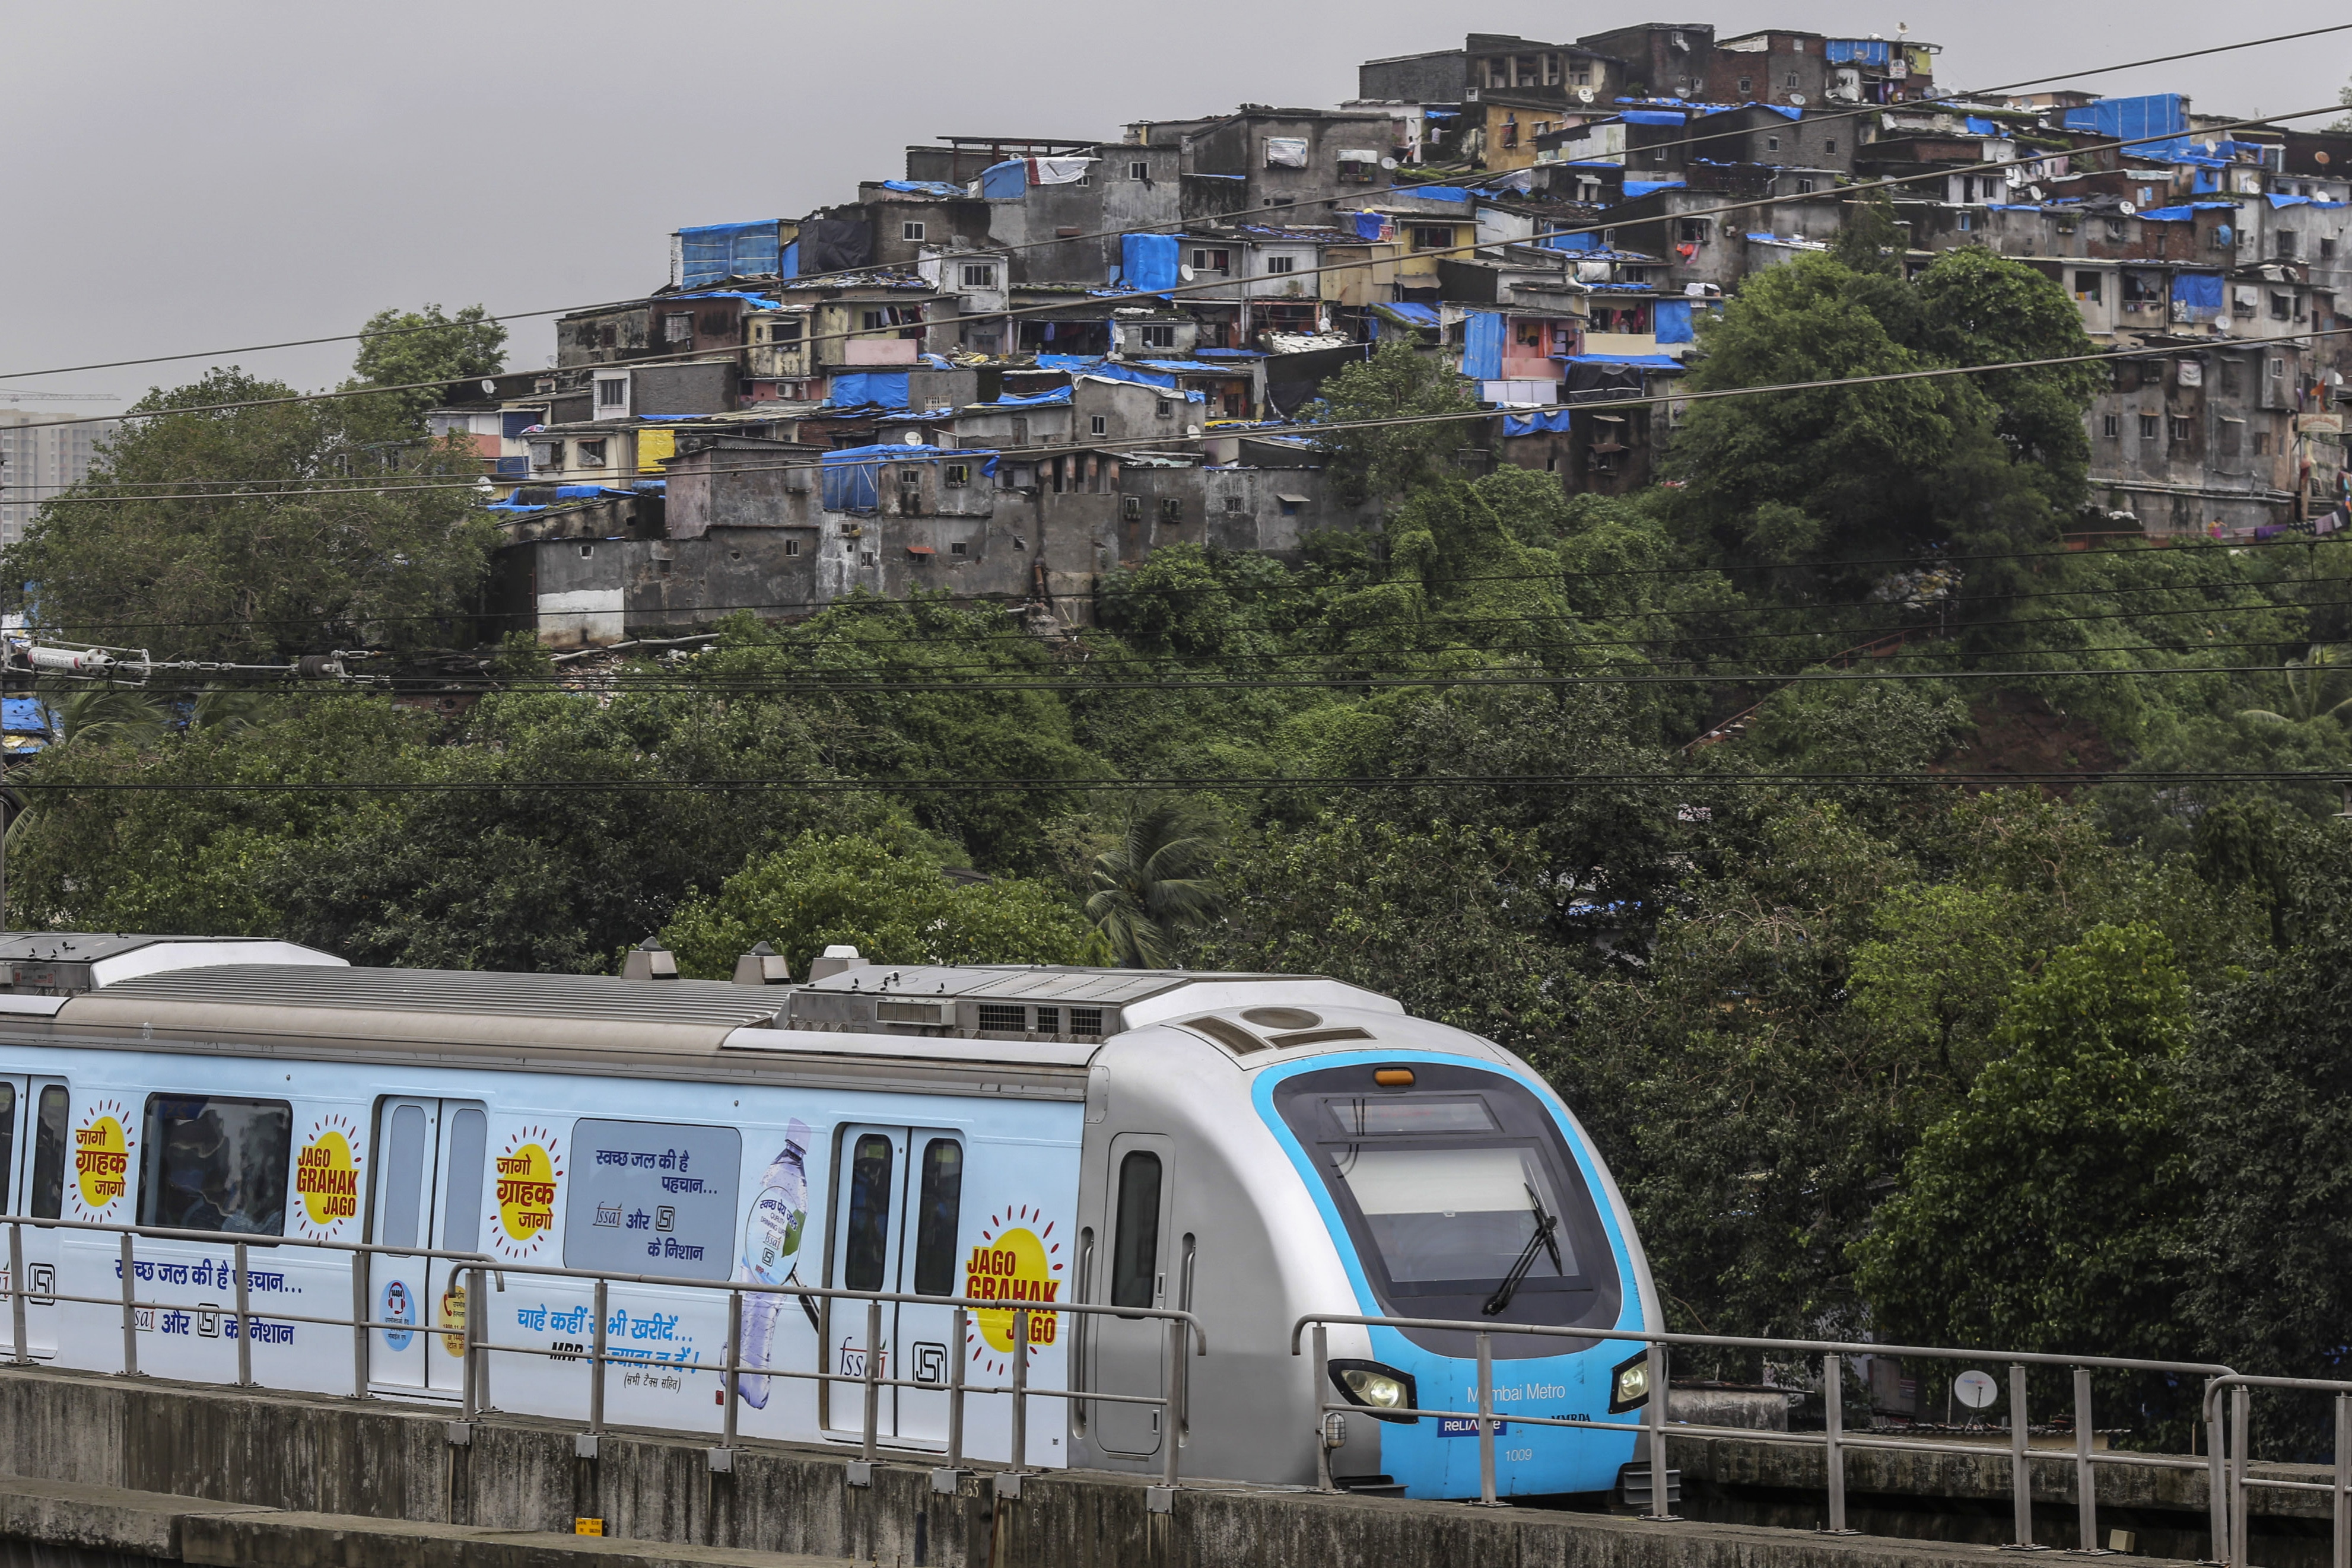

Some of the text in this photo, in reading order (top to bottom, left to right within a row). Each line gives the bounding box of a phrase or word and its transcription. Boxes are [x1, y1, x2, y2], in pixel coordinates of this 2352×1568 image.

[75, 1125, 107, 1146] जागो
[75, 1150, 129, 1176] ग्राहक
[298, 1147, 330, 1168] JAGO
[496, 1153, 532, 1175] जागो
[596, 1149, 689, 1172] स्वच्छ जल की है
[94, 1176, 126, 1197] जागो
[297, 1167, 358, 1195] GRAHAK
[662, 1176, 717, 1194] पहचान...
[497, 1179, 557, 1207] ग्राहक
[323, 1196, 356, 1217] JAGO
[592, 1201, 622, 1228] fssai
[626, 1208, 651, 1230] और
[518, 1207, 553, 1230] जागो
[647, 1237, 704, 1261] के निशान
[157, 1263, 189, 1285] जल
[192, 1258, 213, 1286] की
[217, 1260, 229, 1290] है
[967, 1249, 1016, 1277] JAGO
[967, 1276, 1059, 1315] GRAHAK
[161, 1309, 190, 1335] और
[517, 1303, 547, 1331] चाहे
[551, 1306, 588, 1334] कहीं
[608, 1309, 628, 1337] भी
[631, 1312, 692, 1342] खरीदें...
[1006, 1315, 1056, 1343] JGO
[549, 1341, 584, 1362] MRP
[840, 1336, 888, 1381] fssi
[624, 1372, 681, 1394] (सभी टैक्स सहित)
[1467, 1383, 1565, 1403] Mmbai Metro
[1505, 1448, 1532, 1462] 1009
